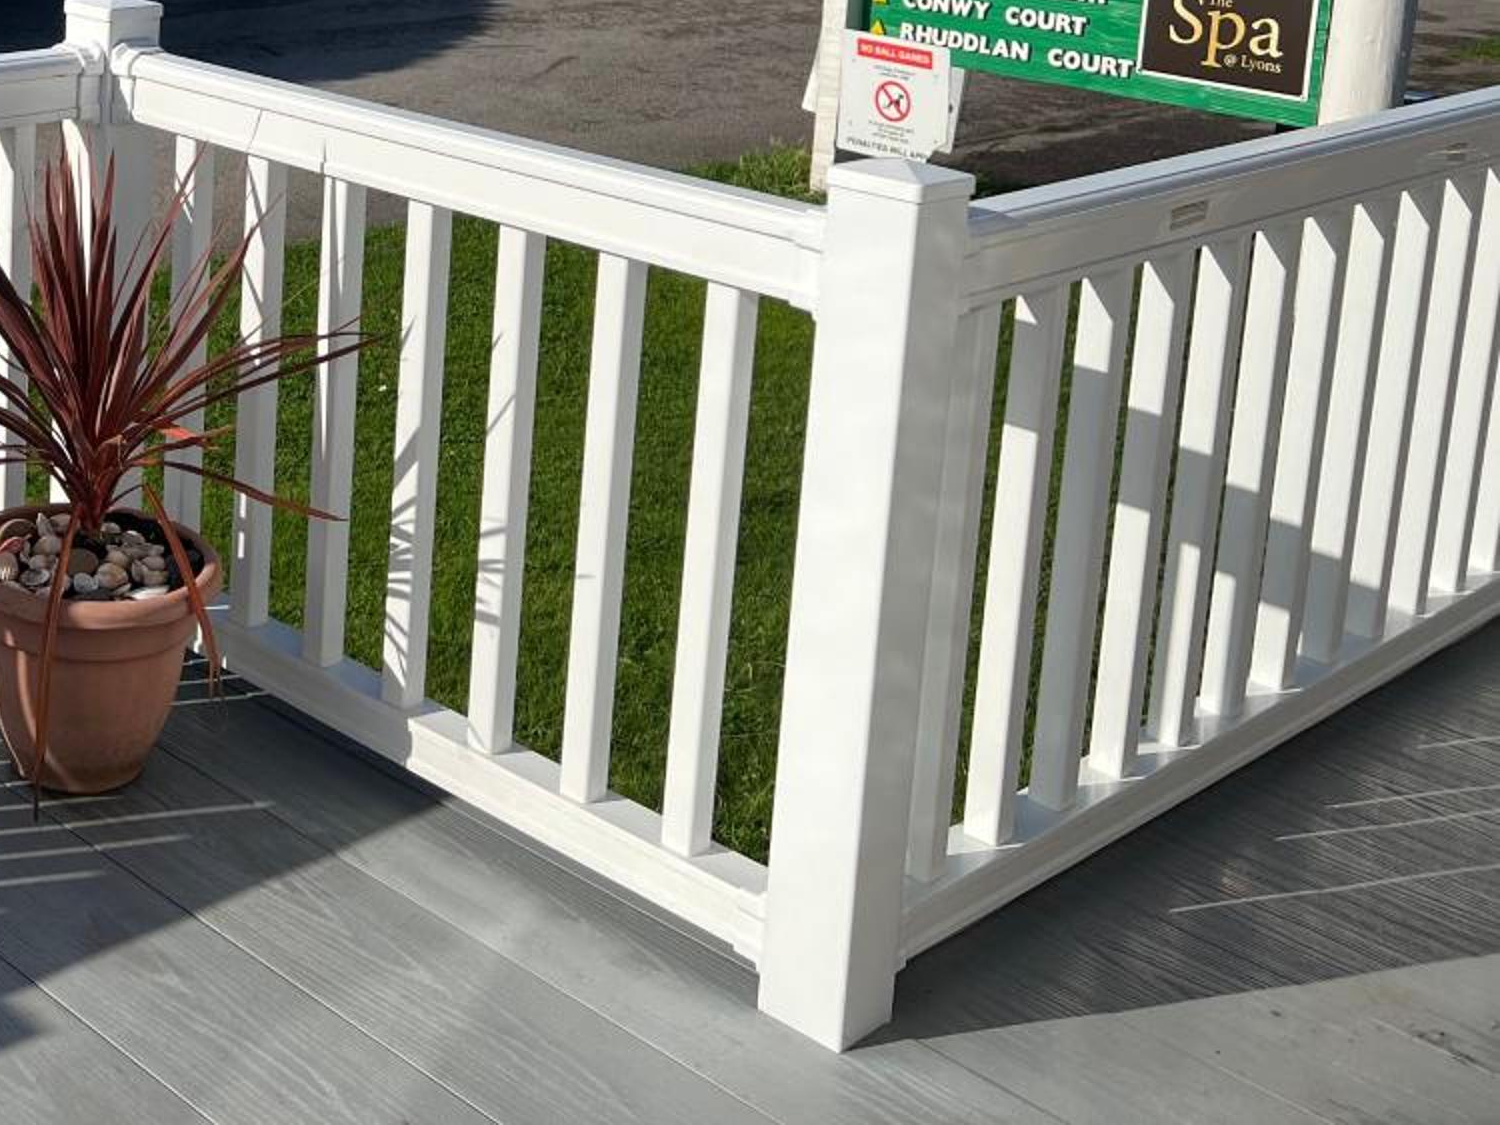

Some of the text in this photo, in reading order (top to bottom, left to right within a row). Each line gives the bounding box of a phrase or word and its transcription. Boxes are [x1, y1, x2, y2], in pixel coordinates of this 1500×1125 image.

[1005, 5, 1087, 36] COURT
[900, 21, 1134, 78] RHUDDLAN COURT
